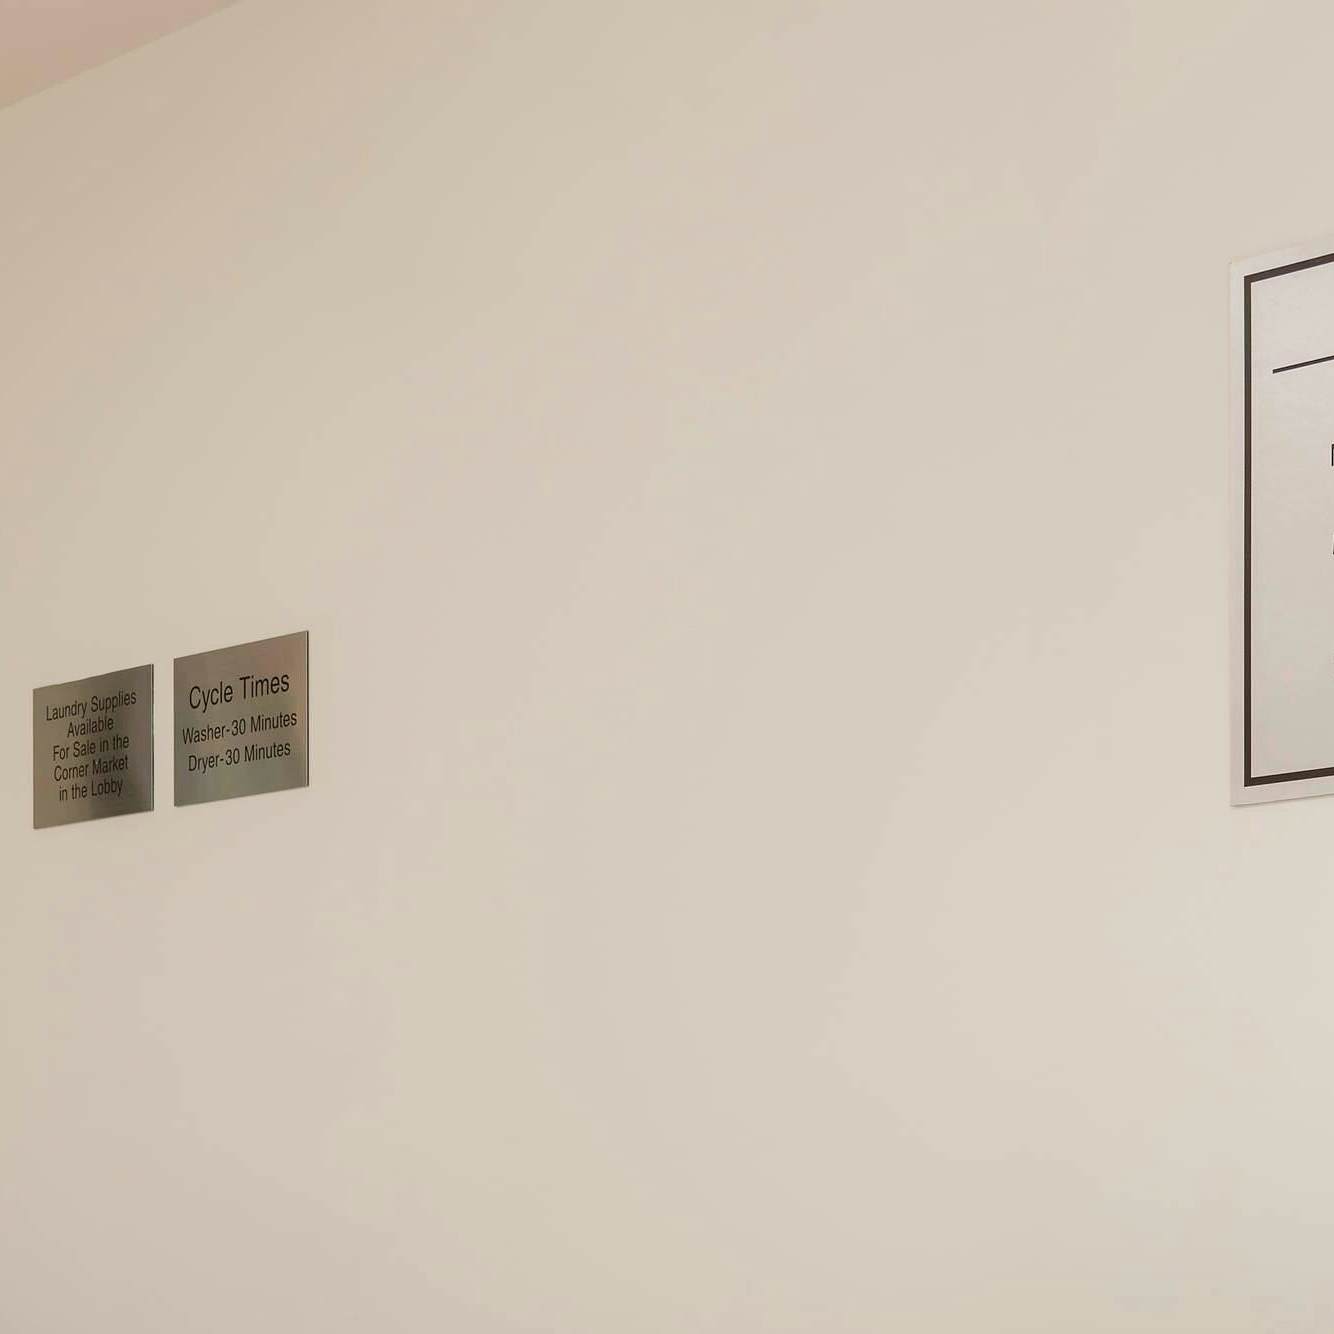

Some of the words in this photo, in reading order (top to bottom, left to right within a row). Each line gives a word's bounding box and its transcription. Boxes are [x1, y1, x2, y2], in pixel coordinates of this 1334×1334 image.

[46, 700, 87, 721] Laundry
[90, 690, 137, 714] Supplies
[189, 681, 233, 713] Cycle
[239, 674, 290, 700] Times
[67, 714, 114, 738] Available
[182, 718, 246, 745] Washer-30
[250, 712, 297, 733] Minutes
[53, 745, 69, 761] For
[73, 739, 96, 758] Sale
[99, 737, 109, 753] in
[113, 734, 129, 751] the
[188, 747, 240, 774] Dryer-30
[244, 742, 291, 762] Minutes
[54, 760, 89, 782] Corner
[92, 754, 128, 775] Market
[59, 786, 68, 801] in
[71, 783, 88, 800] the
[91, 777, 123, 797] Lobby
